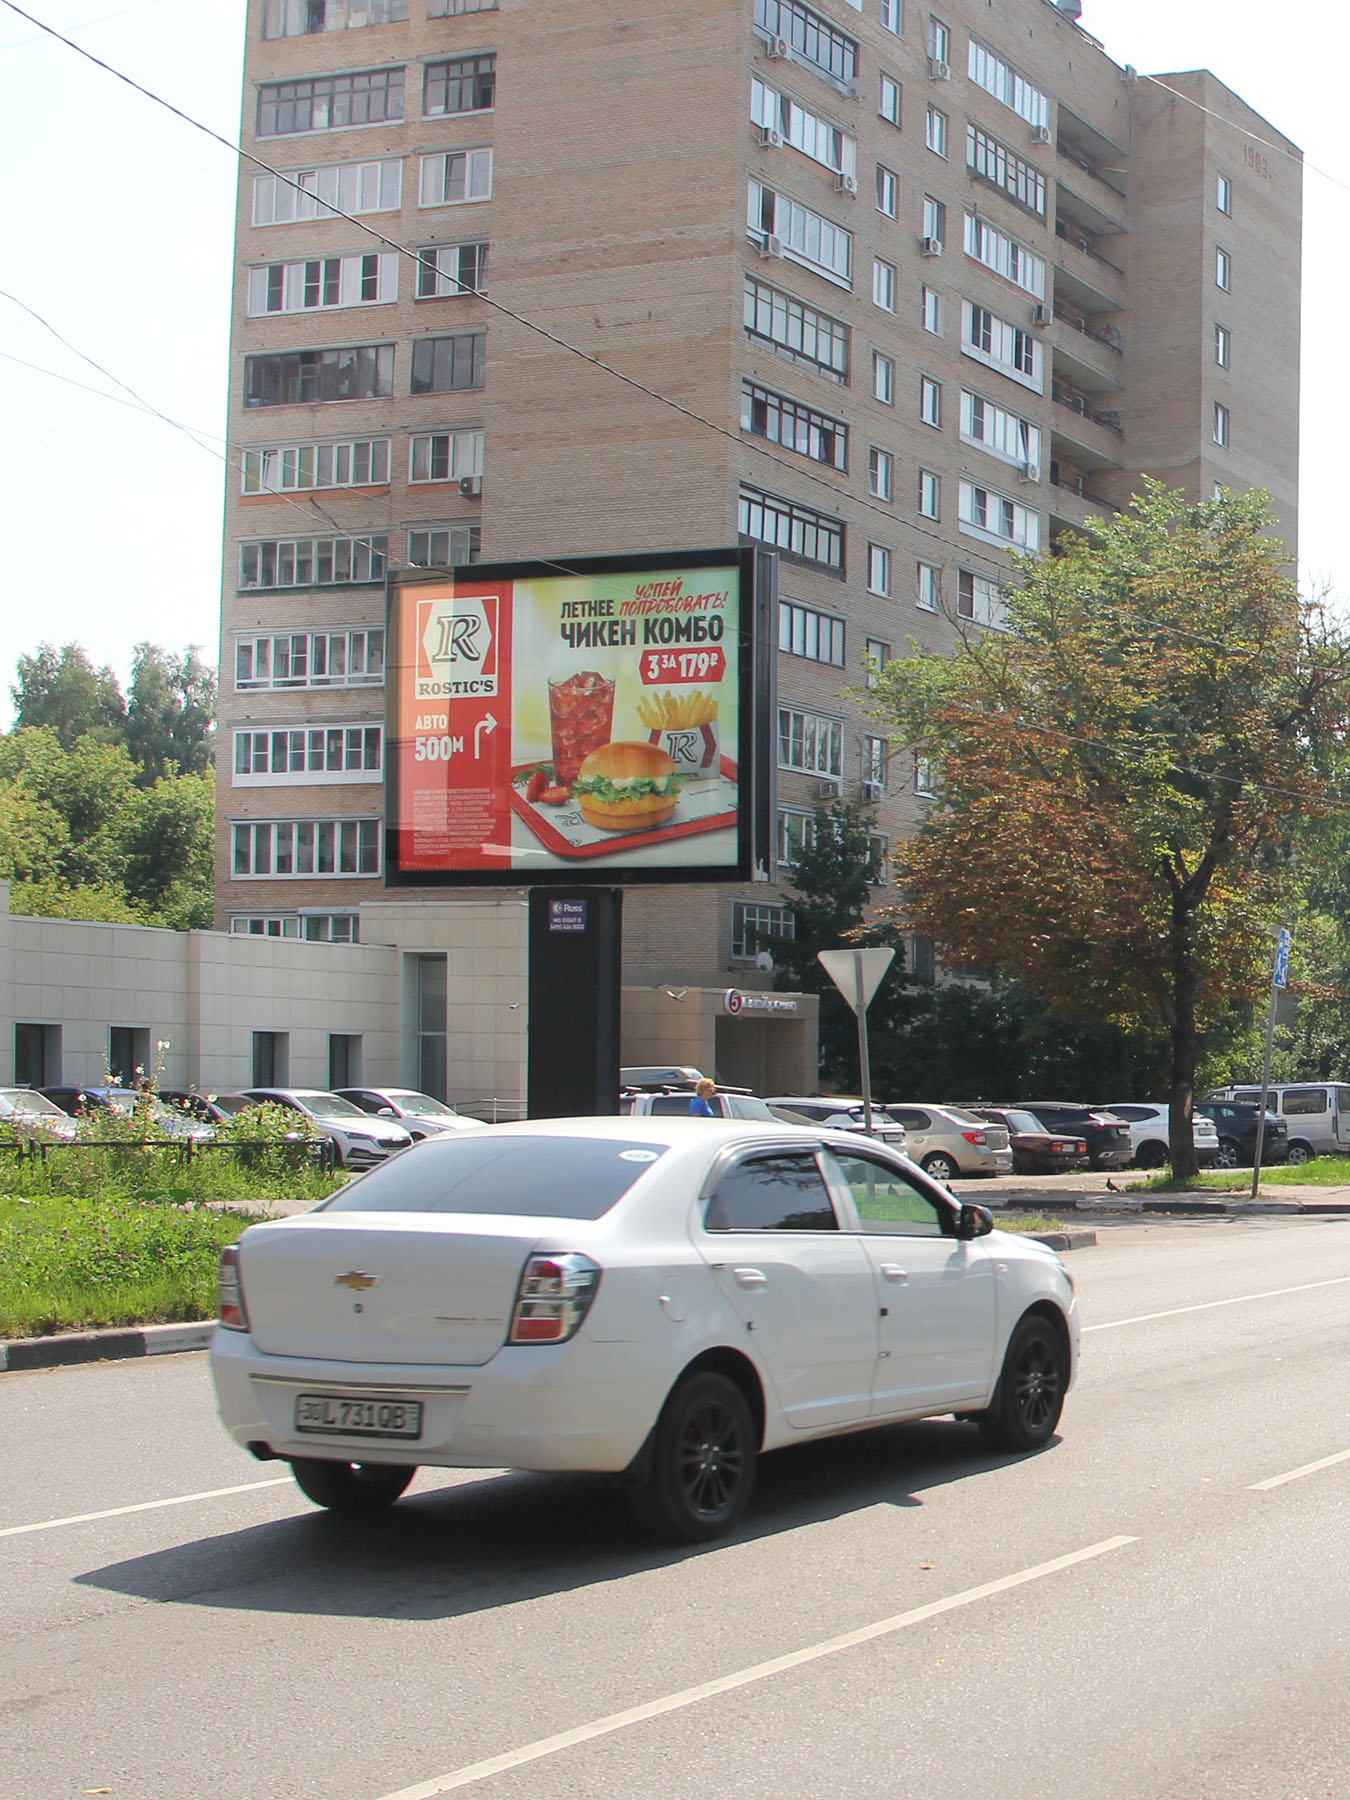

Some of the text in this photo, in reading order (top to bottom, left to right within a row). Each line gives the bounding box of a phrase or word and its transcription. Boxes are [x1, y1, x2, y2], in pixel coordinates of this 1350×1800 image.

[636, 577, 683, 599] УСПЕЙ
[561, 600, 614, 618] ЛЕТНЕЕ
[619, 591, 729, 616] ПОПРОБОВАТЬ!
[432, 615, 481, 663] R
[561, 615, 724, 648] ЧИКЕН КОМБО
[647, 655, 660, 679] 3
[419, 680, 494, 695] ROSTIC'S
[415, 714, 448, 730] АВТО
